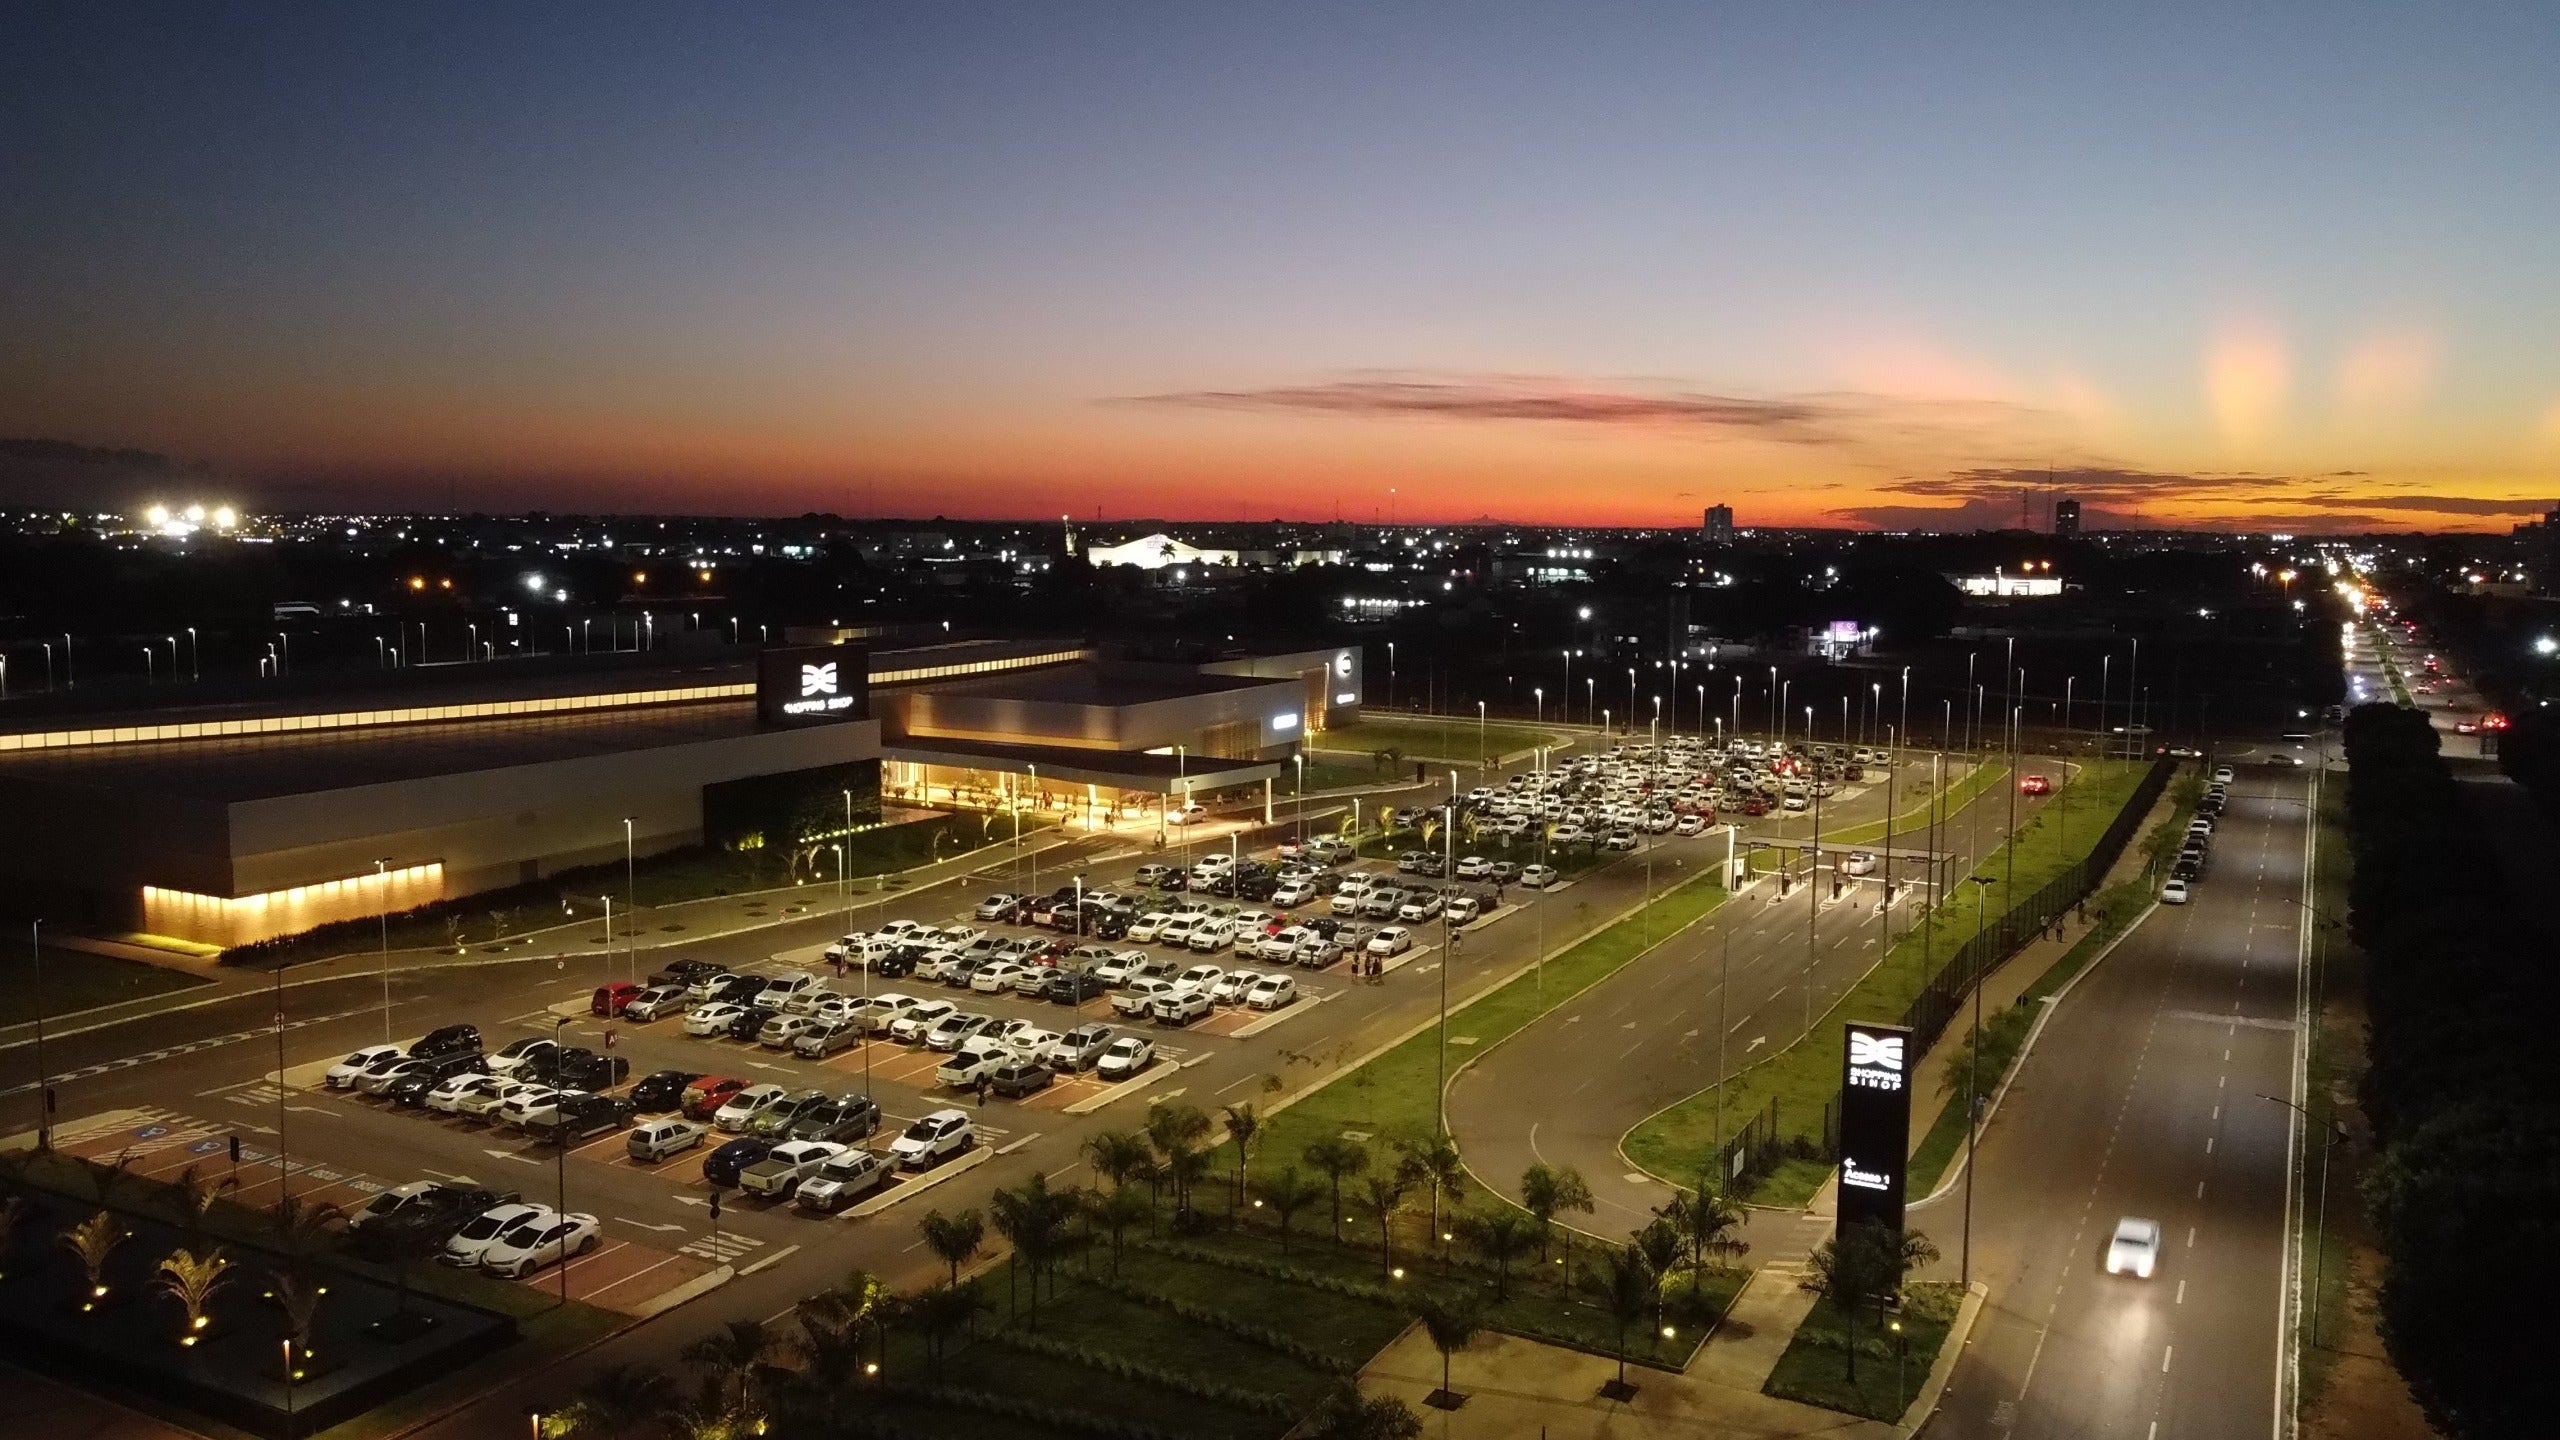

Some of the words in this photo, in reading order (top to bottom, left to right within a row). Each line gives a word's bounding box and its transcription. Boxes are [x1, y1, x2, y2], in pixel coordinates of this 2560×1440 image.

[1850, 1067, 1902, 1083] SHOPPING
[1850, 1075, 1902, 1091] SINOP
[1844, 1168, 1882, 1183] Acesso
[1884, 1174, 1890, 1184] 1
